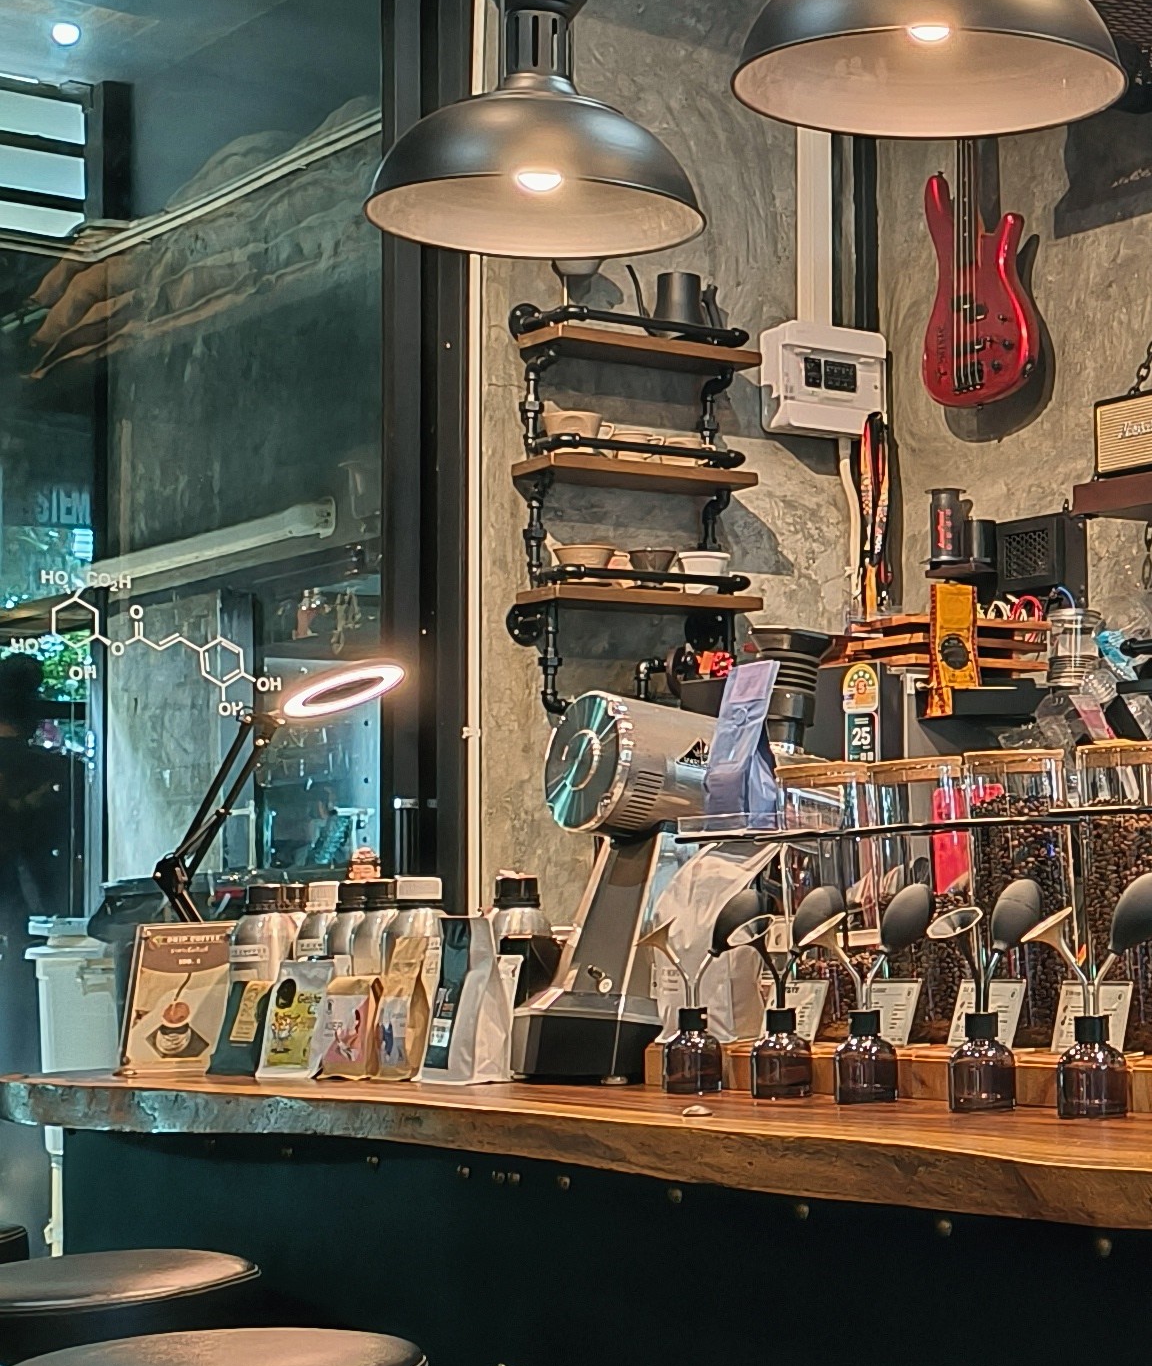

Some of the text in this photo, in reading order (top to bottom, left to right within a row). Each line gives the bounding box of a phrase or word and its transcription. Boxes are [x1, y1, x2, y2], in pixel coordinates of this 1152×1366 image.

[41, 570, 68, 585] HO
[10, 637, 39, 653] HO
[68, 664, 97, 681] OH
[256, 676, 282, 692] OH
[851, 726, 871, 746] 25
